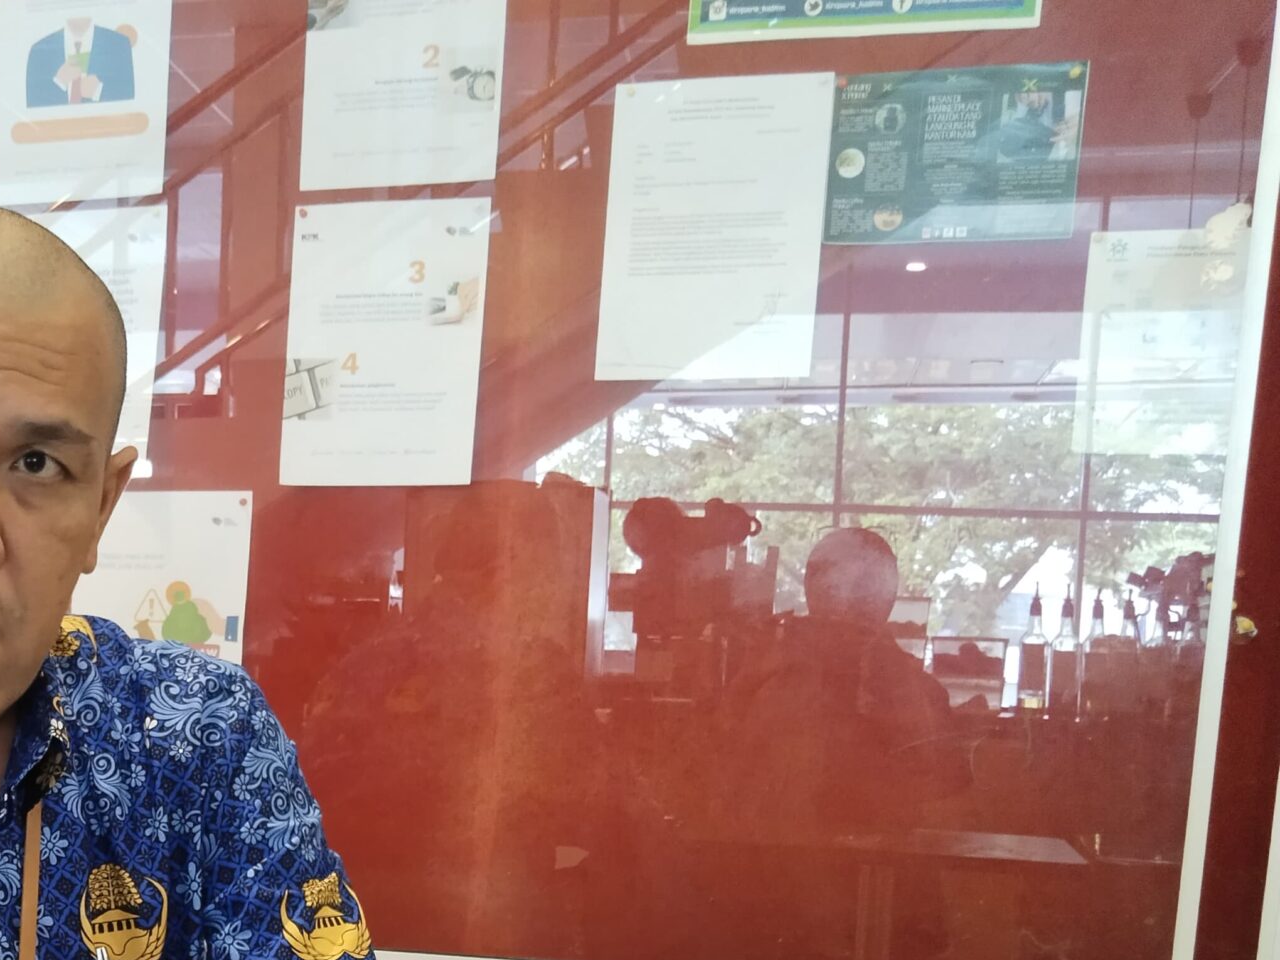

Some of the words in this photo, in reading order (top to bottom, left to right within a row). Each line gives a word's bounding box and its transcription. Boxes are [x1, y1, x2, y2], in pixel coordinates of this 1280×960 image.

[423, 44, 440, 69] 2
[409, 260, 426, 284] 3
[340, 352, 360, 376] 4
